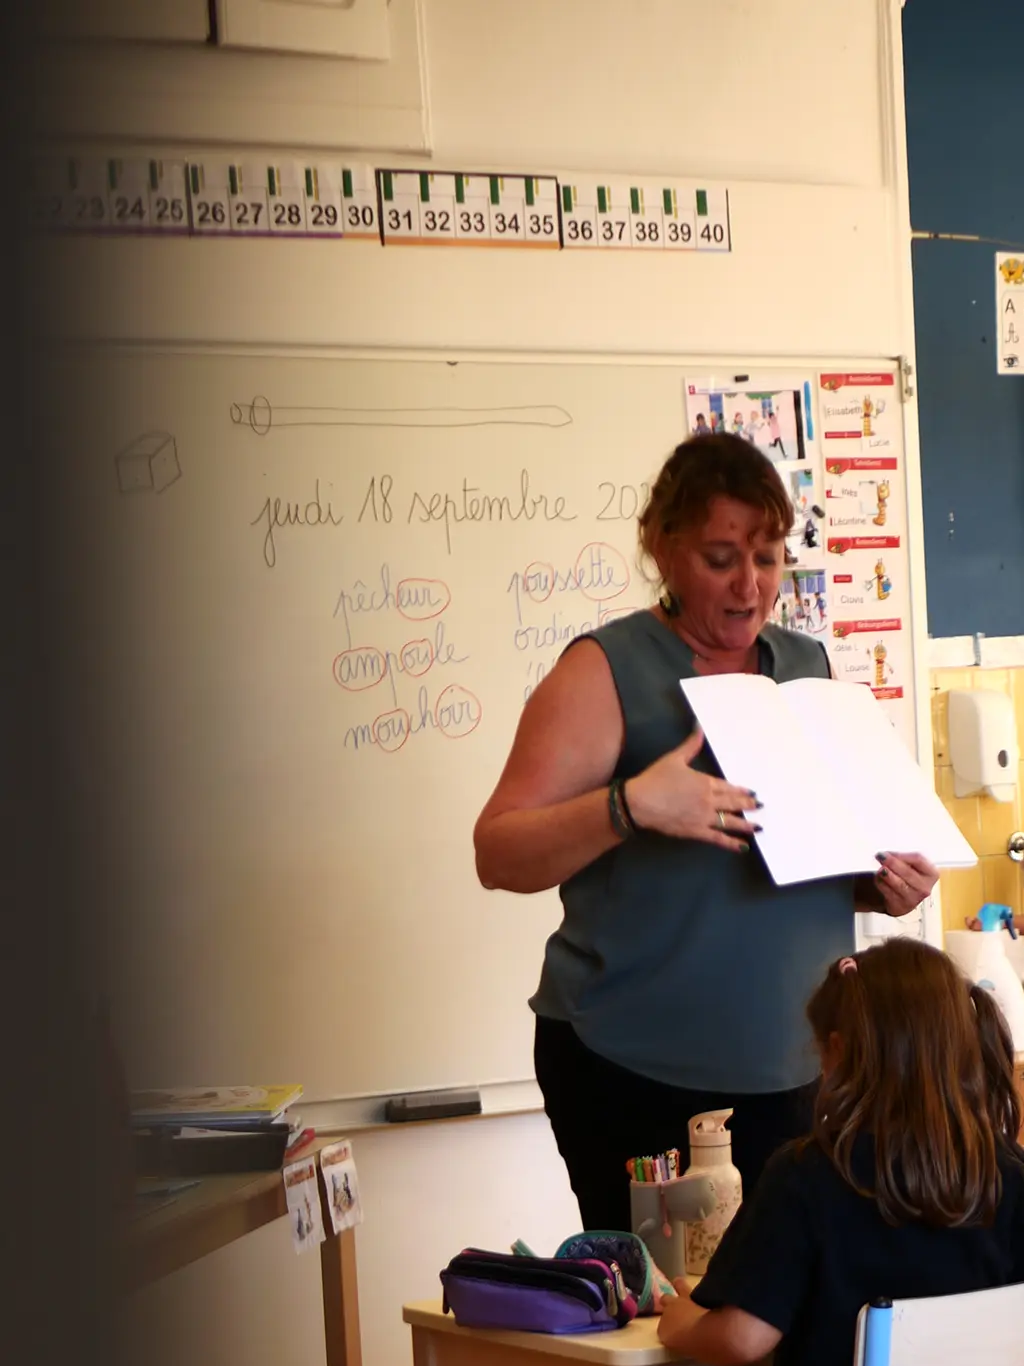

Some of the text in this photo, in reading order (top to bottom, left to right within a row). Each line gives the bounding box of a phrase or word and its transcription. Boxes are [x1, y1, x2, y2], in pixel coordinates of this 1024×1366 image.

[115, 197, 147, 219] 24
[155, 199, 184, 221] 25
[196, 202, 226, 225] 26
[235, 202, 263, 226] 27
[273, 204, 301, 226] 28
[310, 204, 338, 227] 29
[348, 205, 373, 227] 30
[388, 209, 413, 231] 31
[424, 211, 451, 232] 32
[459, 212, 485, 233] 33
[495, 212, 520, 234] 34
[529, 214, 554, 235] 35
[567, 220, 594, 241] 36
[602, 220, 626, 241] 37
[635, 221, 660, 242] 38
[668, 222, 692, 242] 39
[700, 223, 724, 243] 40
[1005, 299, 1016, 314] A
[250, 473, 344, 568] jeudi
[358, 474, 393, 523] 18
[408, 468, 578, 555] septembre
[333, 563, 444, 651] pêcheur
[507, 547, 627, 625] poussette
[338, 621, 470, 708] ampoule
[343, 685, 480, 751] mouchoir
